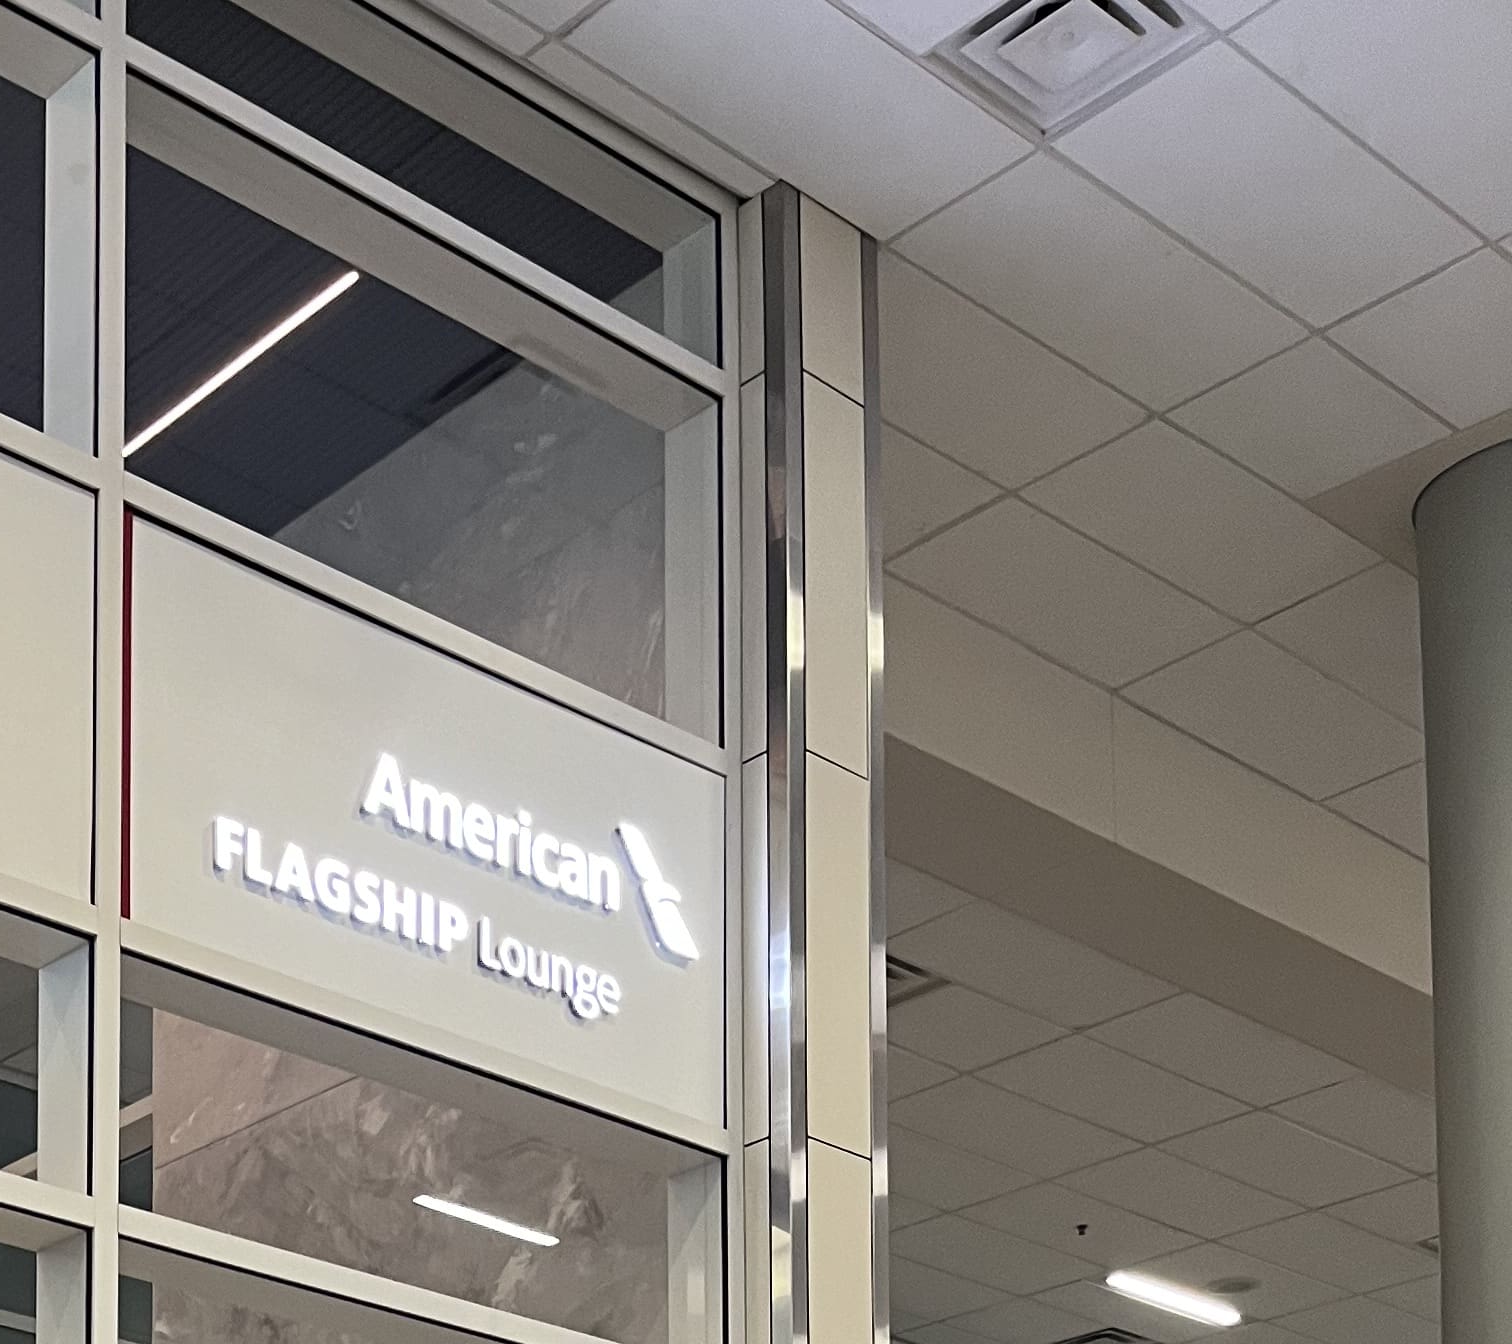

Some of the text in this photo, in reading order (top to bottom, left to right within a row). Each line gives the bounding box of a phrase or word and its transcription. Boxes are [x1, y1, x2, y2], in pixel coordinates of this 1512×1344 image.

[213, 815, 621, 1020] FLAGSHIP Lounge
[361, 751, 620, 912] American
